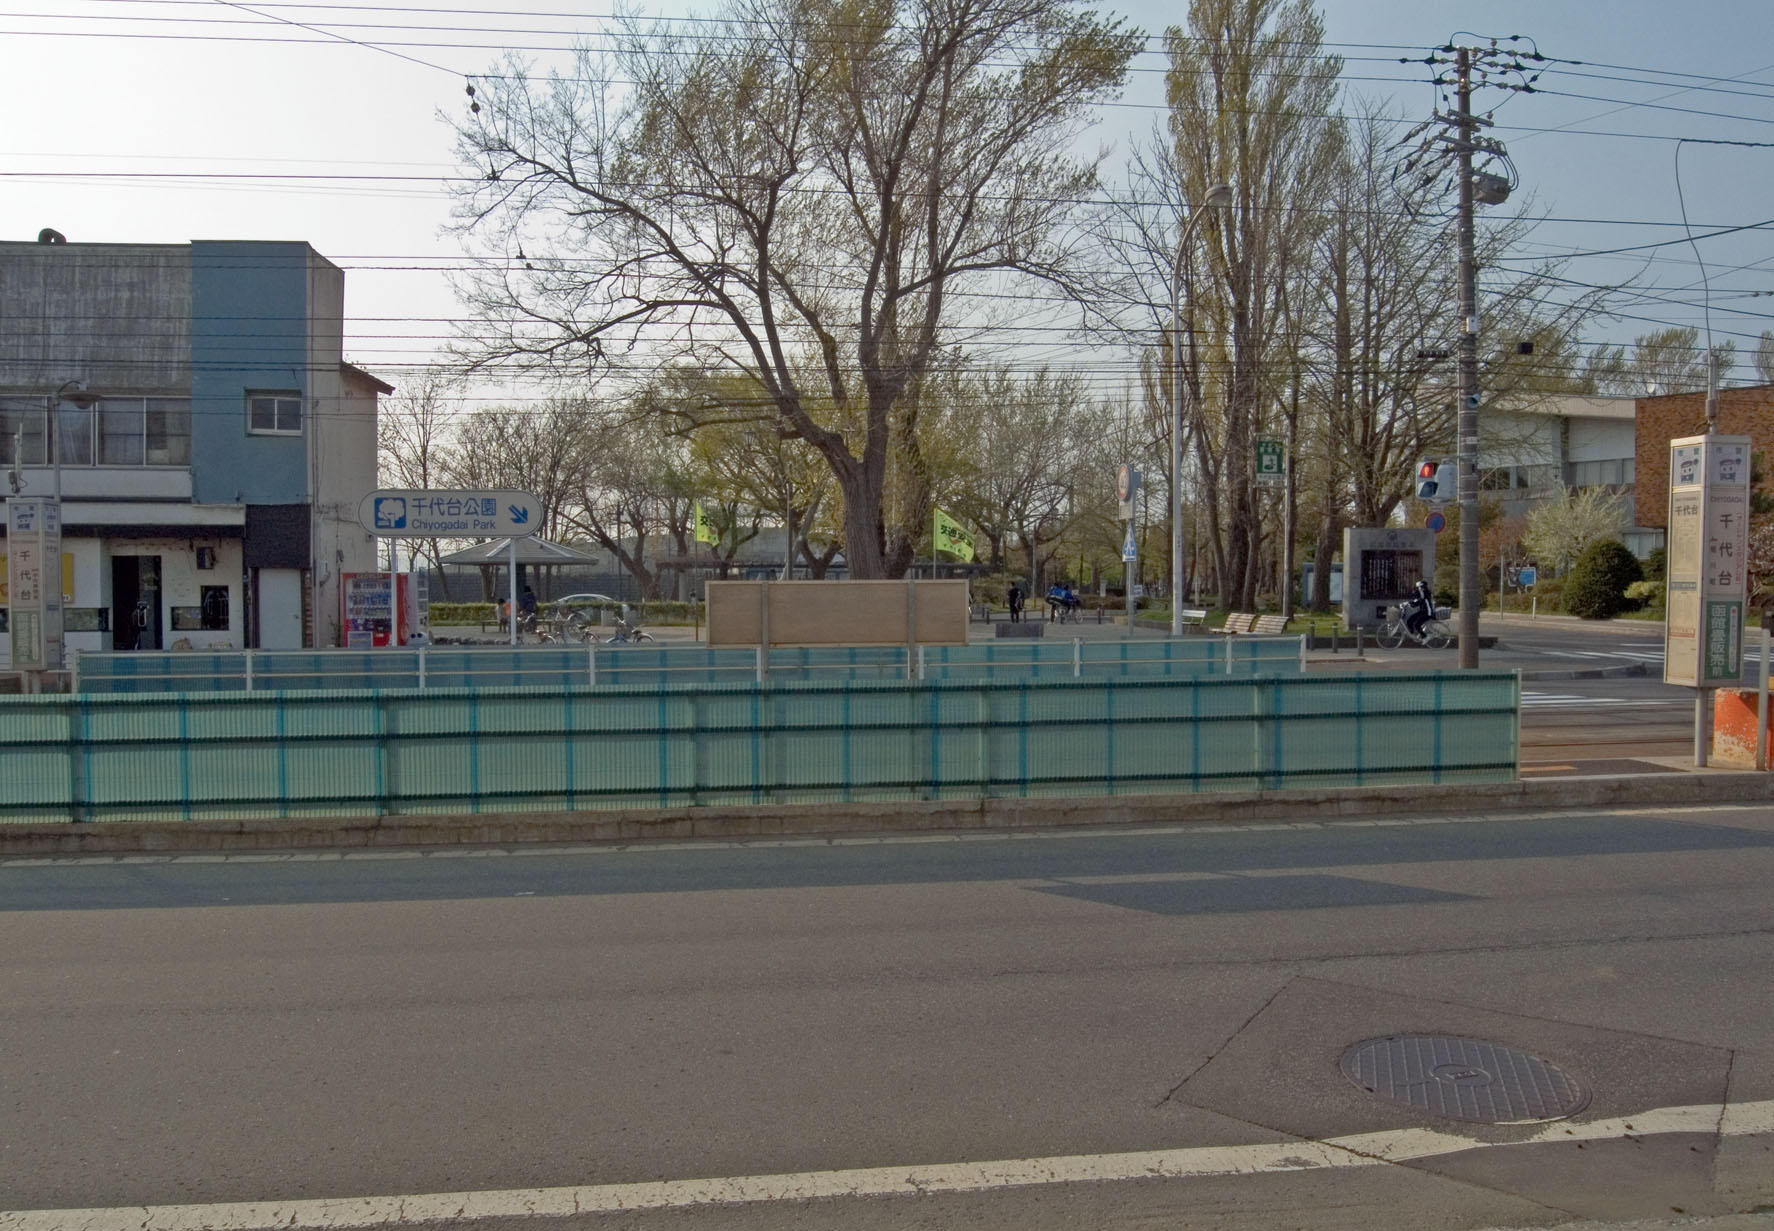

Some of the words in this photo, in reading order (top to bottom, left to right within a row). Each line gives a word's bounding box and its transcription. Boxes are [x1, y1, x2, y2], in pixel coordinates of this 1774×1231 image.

[411, 497, 497, 516] 千代台公園
[1675, 504, 1698, 516] 千代台
[412, 519, 468, 531] Chiyogadai
[473, 519, 497, 530] Park
[1718, 513, 1734, 586] 千代台
[19, 550, 31, 601] 千代台
